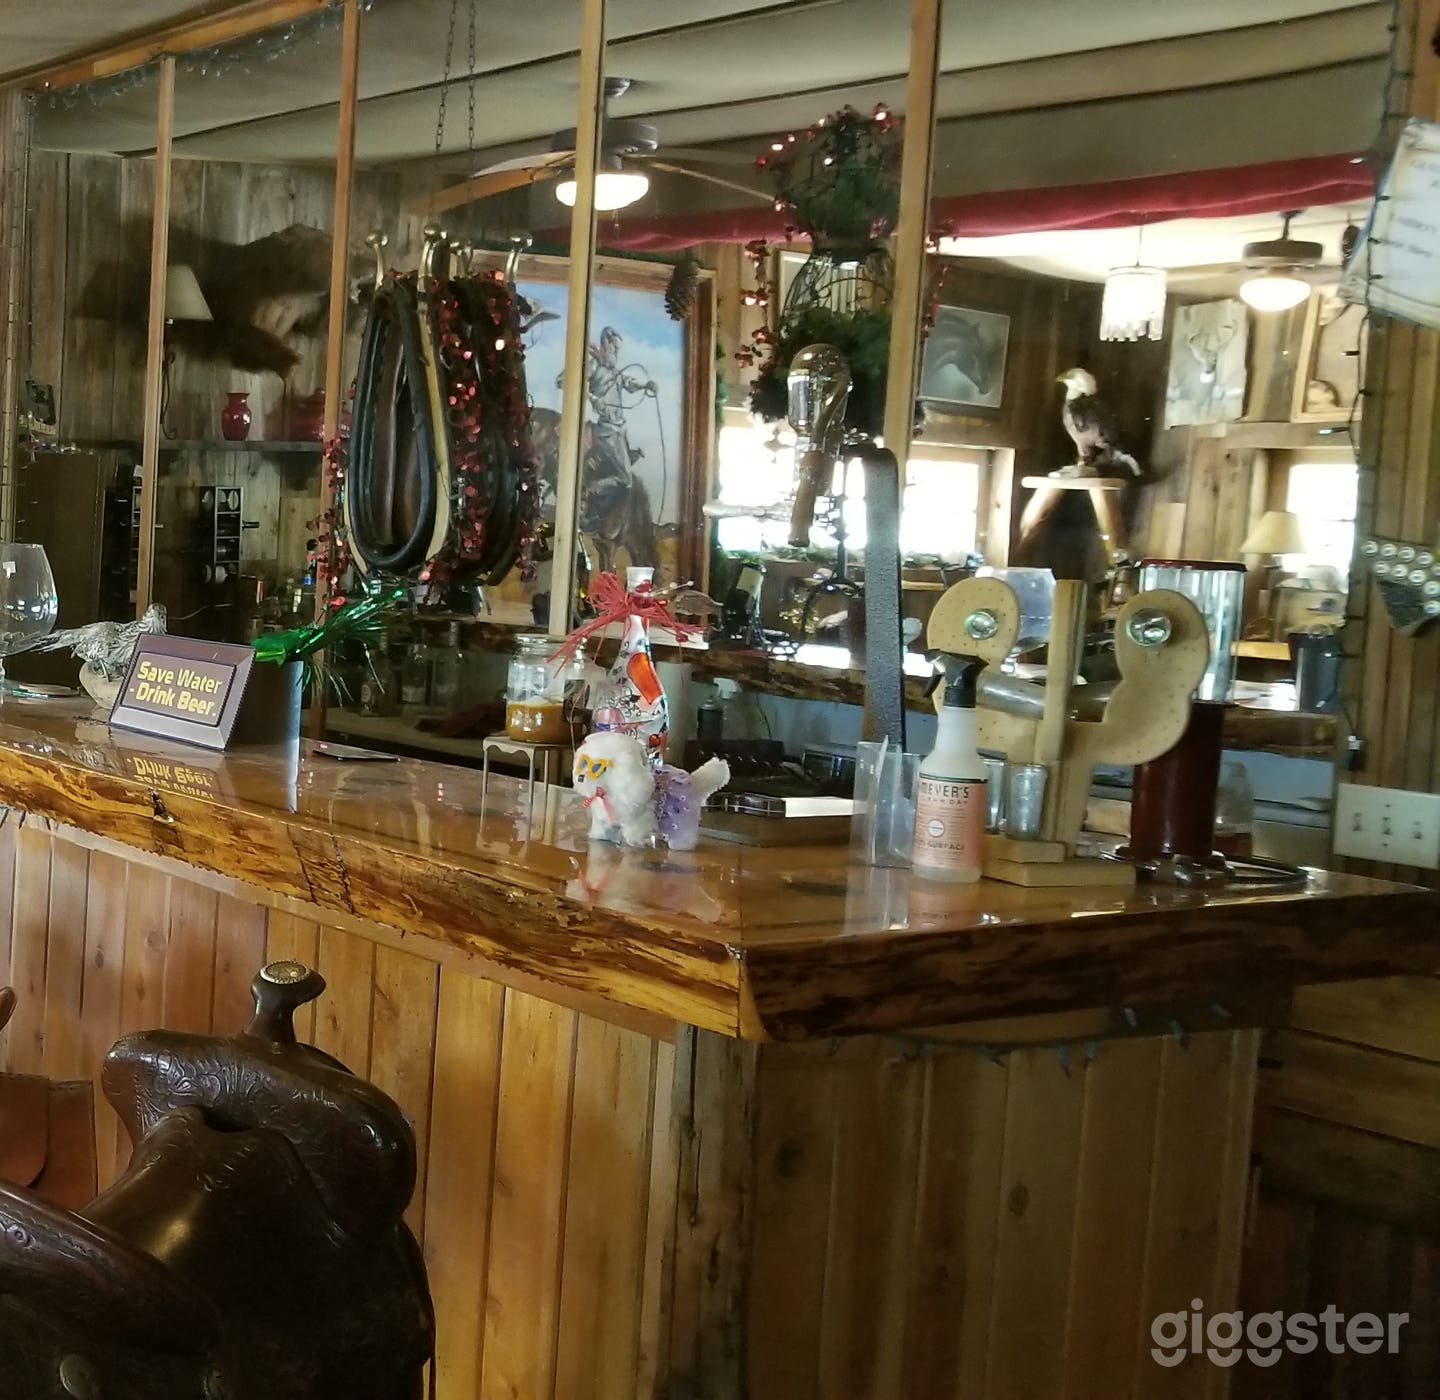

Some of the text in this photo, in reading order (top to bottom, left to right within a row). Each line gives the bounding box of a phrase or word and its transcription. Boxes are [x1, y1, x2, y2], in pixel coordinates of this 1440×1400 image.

[138, 661, 222, 694] Save Water
[135, 682, 175, 707] Drink
[177, 691, 216, 716] Beer.
